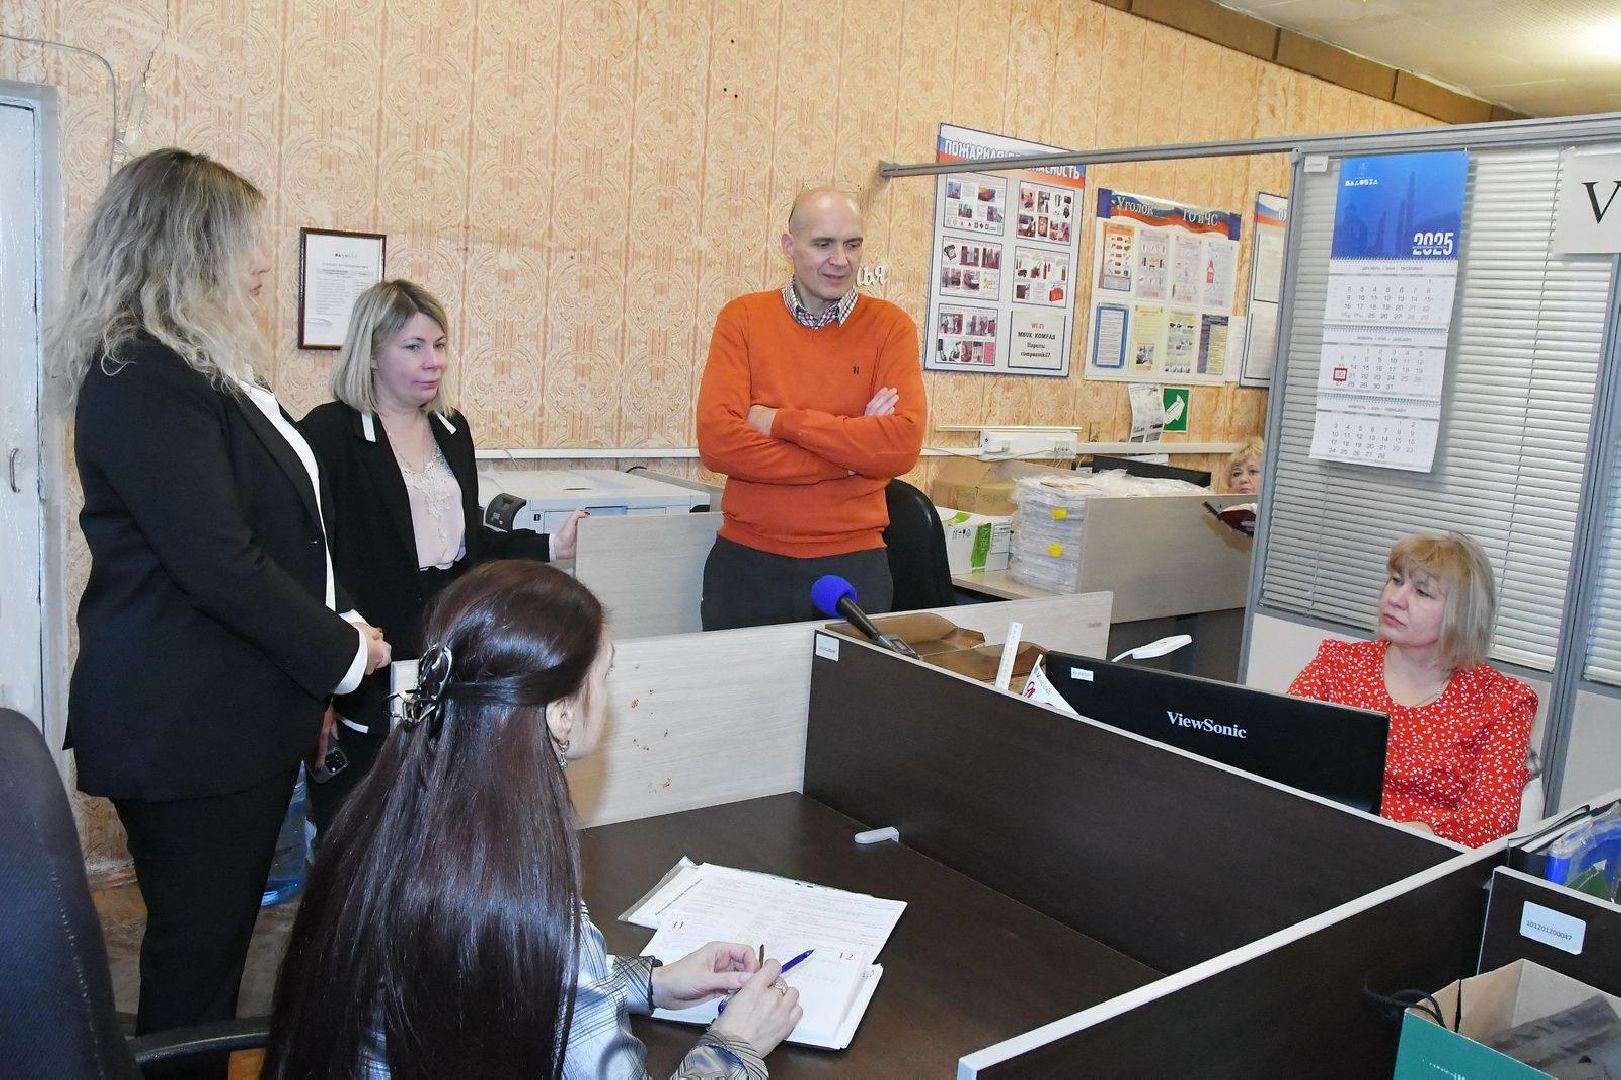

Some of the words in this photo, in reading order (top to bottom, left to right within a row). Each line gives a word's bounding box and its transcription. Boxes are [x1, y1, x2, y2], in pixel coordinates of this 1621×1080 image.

[1117, 196, 1153, 216] Уголок
[1412, 232, 1454, 256] 2025
[1166, 710, 1247, 739] ViewSonic
